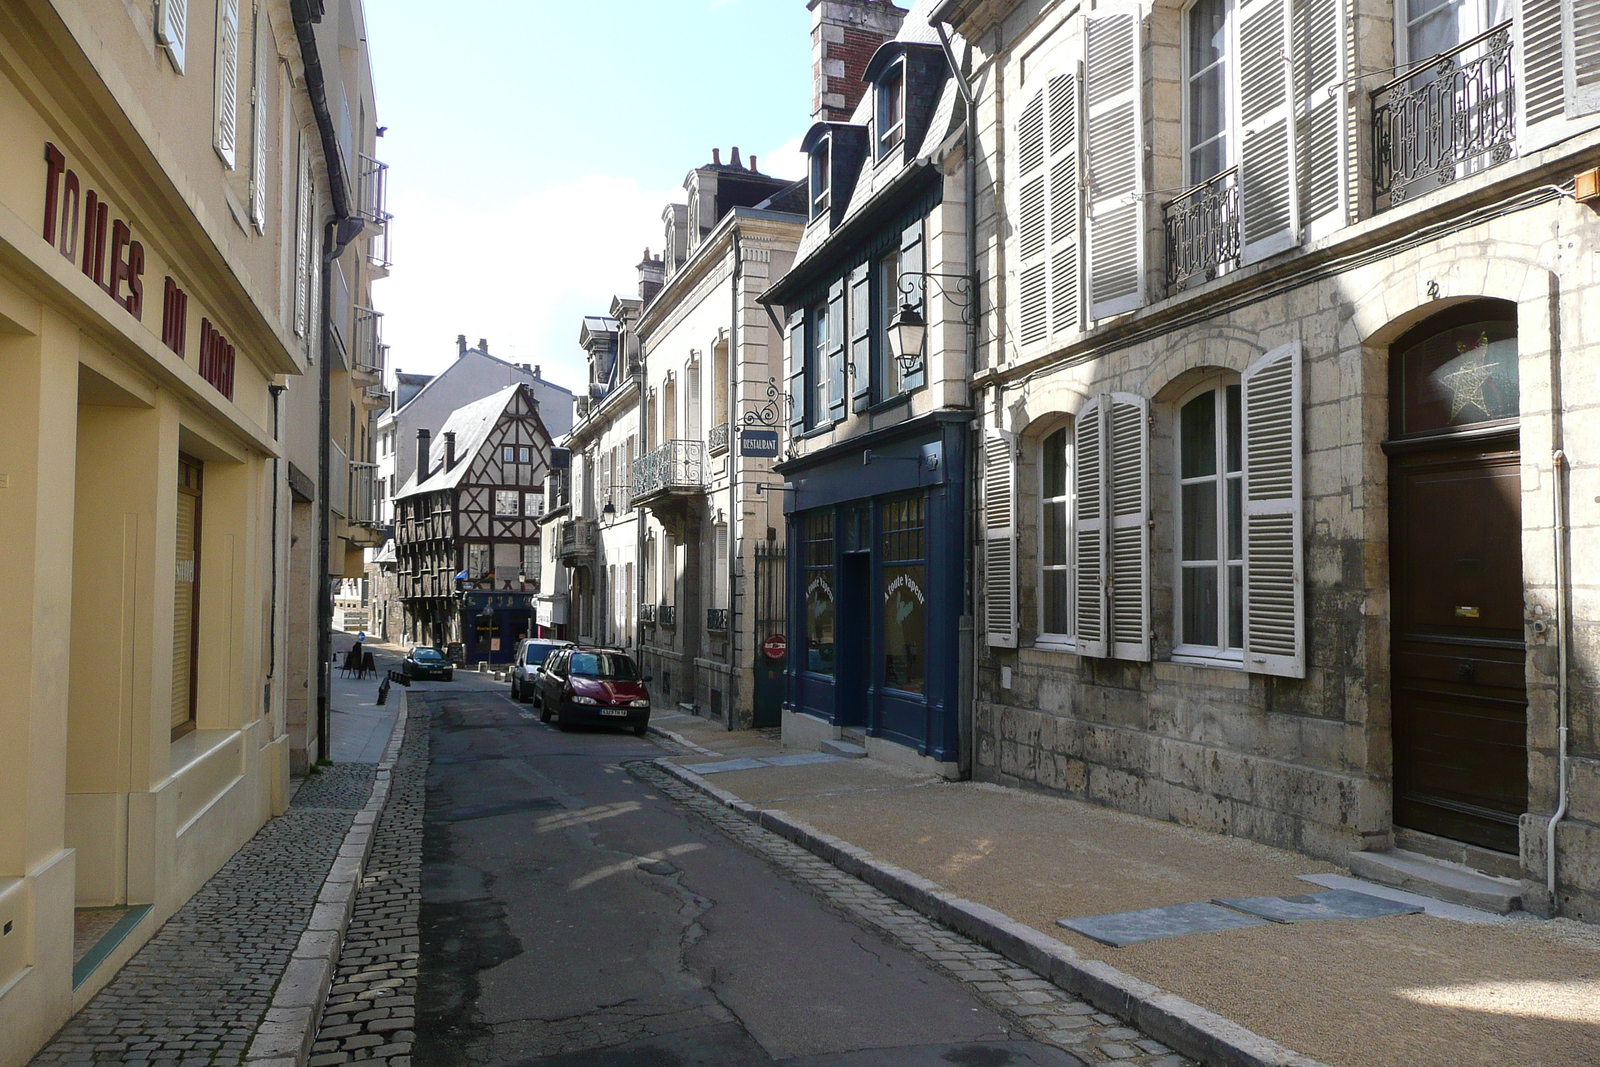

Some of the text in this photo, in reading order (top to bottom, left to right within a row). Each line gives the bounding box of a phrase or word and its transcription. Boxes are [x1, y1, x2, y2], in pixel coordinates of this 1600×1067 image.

[42, 141, 236, 403] TOILES DU NORD
[1427, 280, 1441, 300] 22
[743, 438, 776, 450] RESTAURANT
[888, 575, 904, 595] toute
[904, 573, 925, 605] Vapeur
